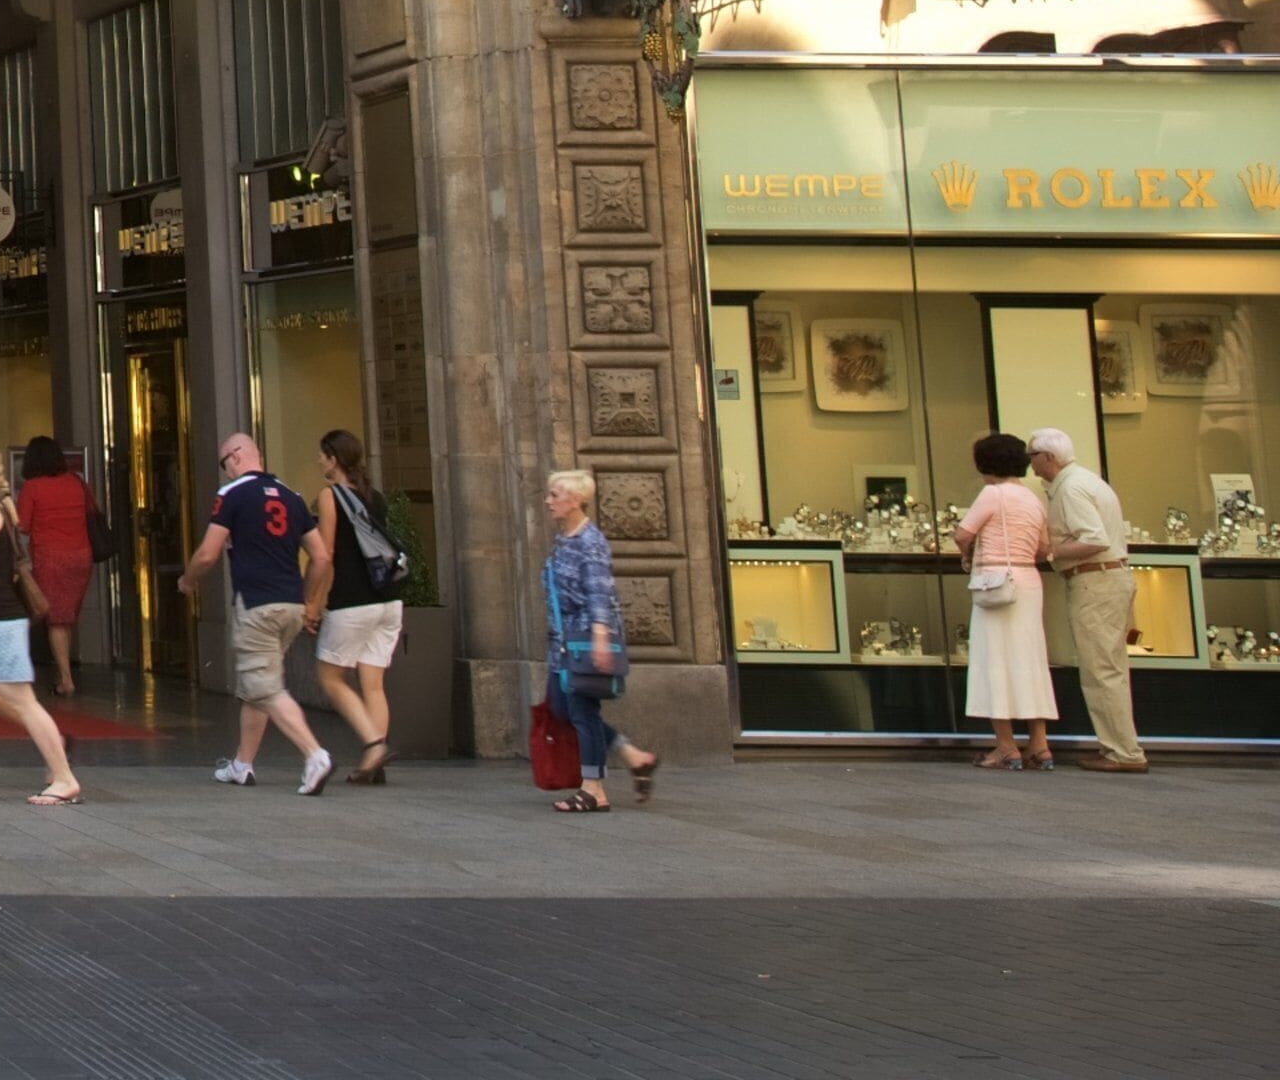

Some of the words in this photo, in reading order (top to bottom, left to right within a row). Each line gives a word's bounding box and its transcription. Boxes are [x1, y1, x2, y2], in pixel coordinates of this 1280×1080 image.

[722, 174, 885, 198] WEMPE
[1002, 167, 1218, 208] ROLEX
[269, 190, 352, 233] WEMPE
[264, 499, 288, 537] 3
